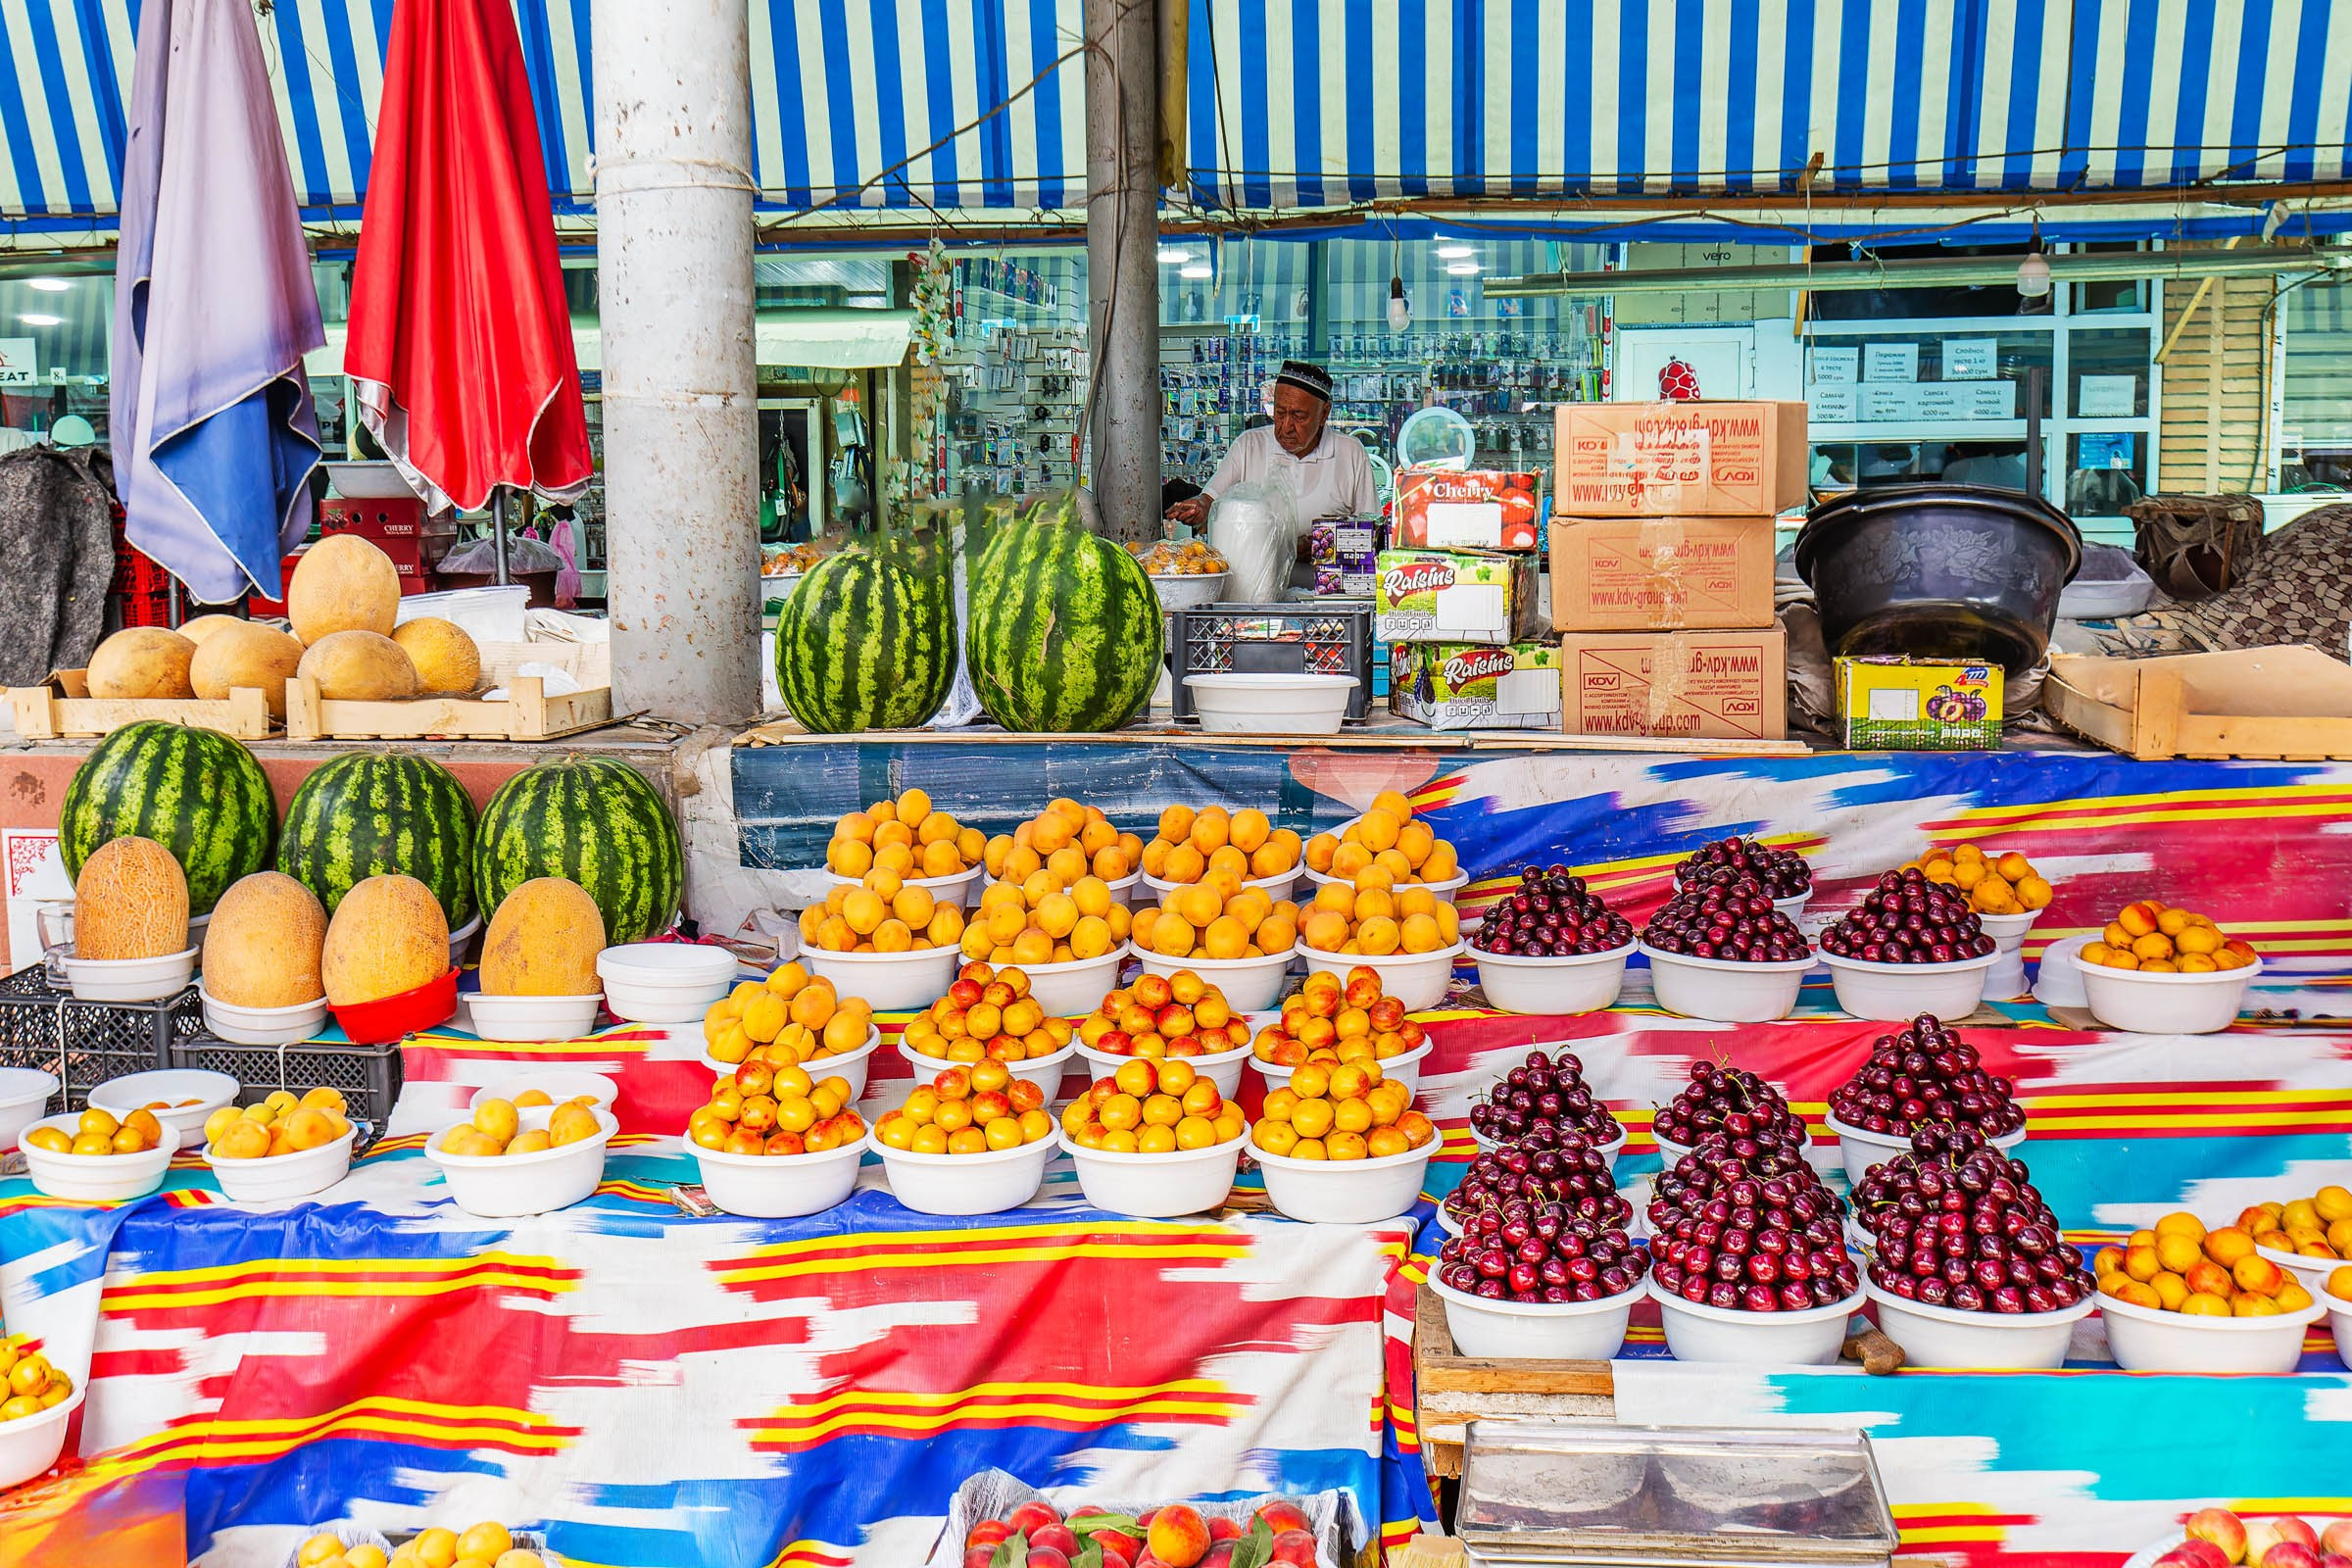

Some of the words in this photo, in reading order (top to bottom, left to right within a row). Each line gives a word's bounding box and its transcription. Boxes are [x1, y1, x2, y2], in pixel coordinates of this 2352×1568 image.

[1702, 251, 1732, 261] vero
[1433, 481, 1494, 501] Cherry
[1593, 560, 1619, 568] KDV
[1383, 566, 1455, 598] Raisins
[1708, 581, 1733, 590] KDV
[1443, 653, 1514, 685] Raisins
[1588, 676, 1617, 686] KDV
[1726, 703, 1755, 711] KDV
